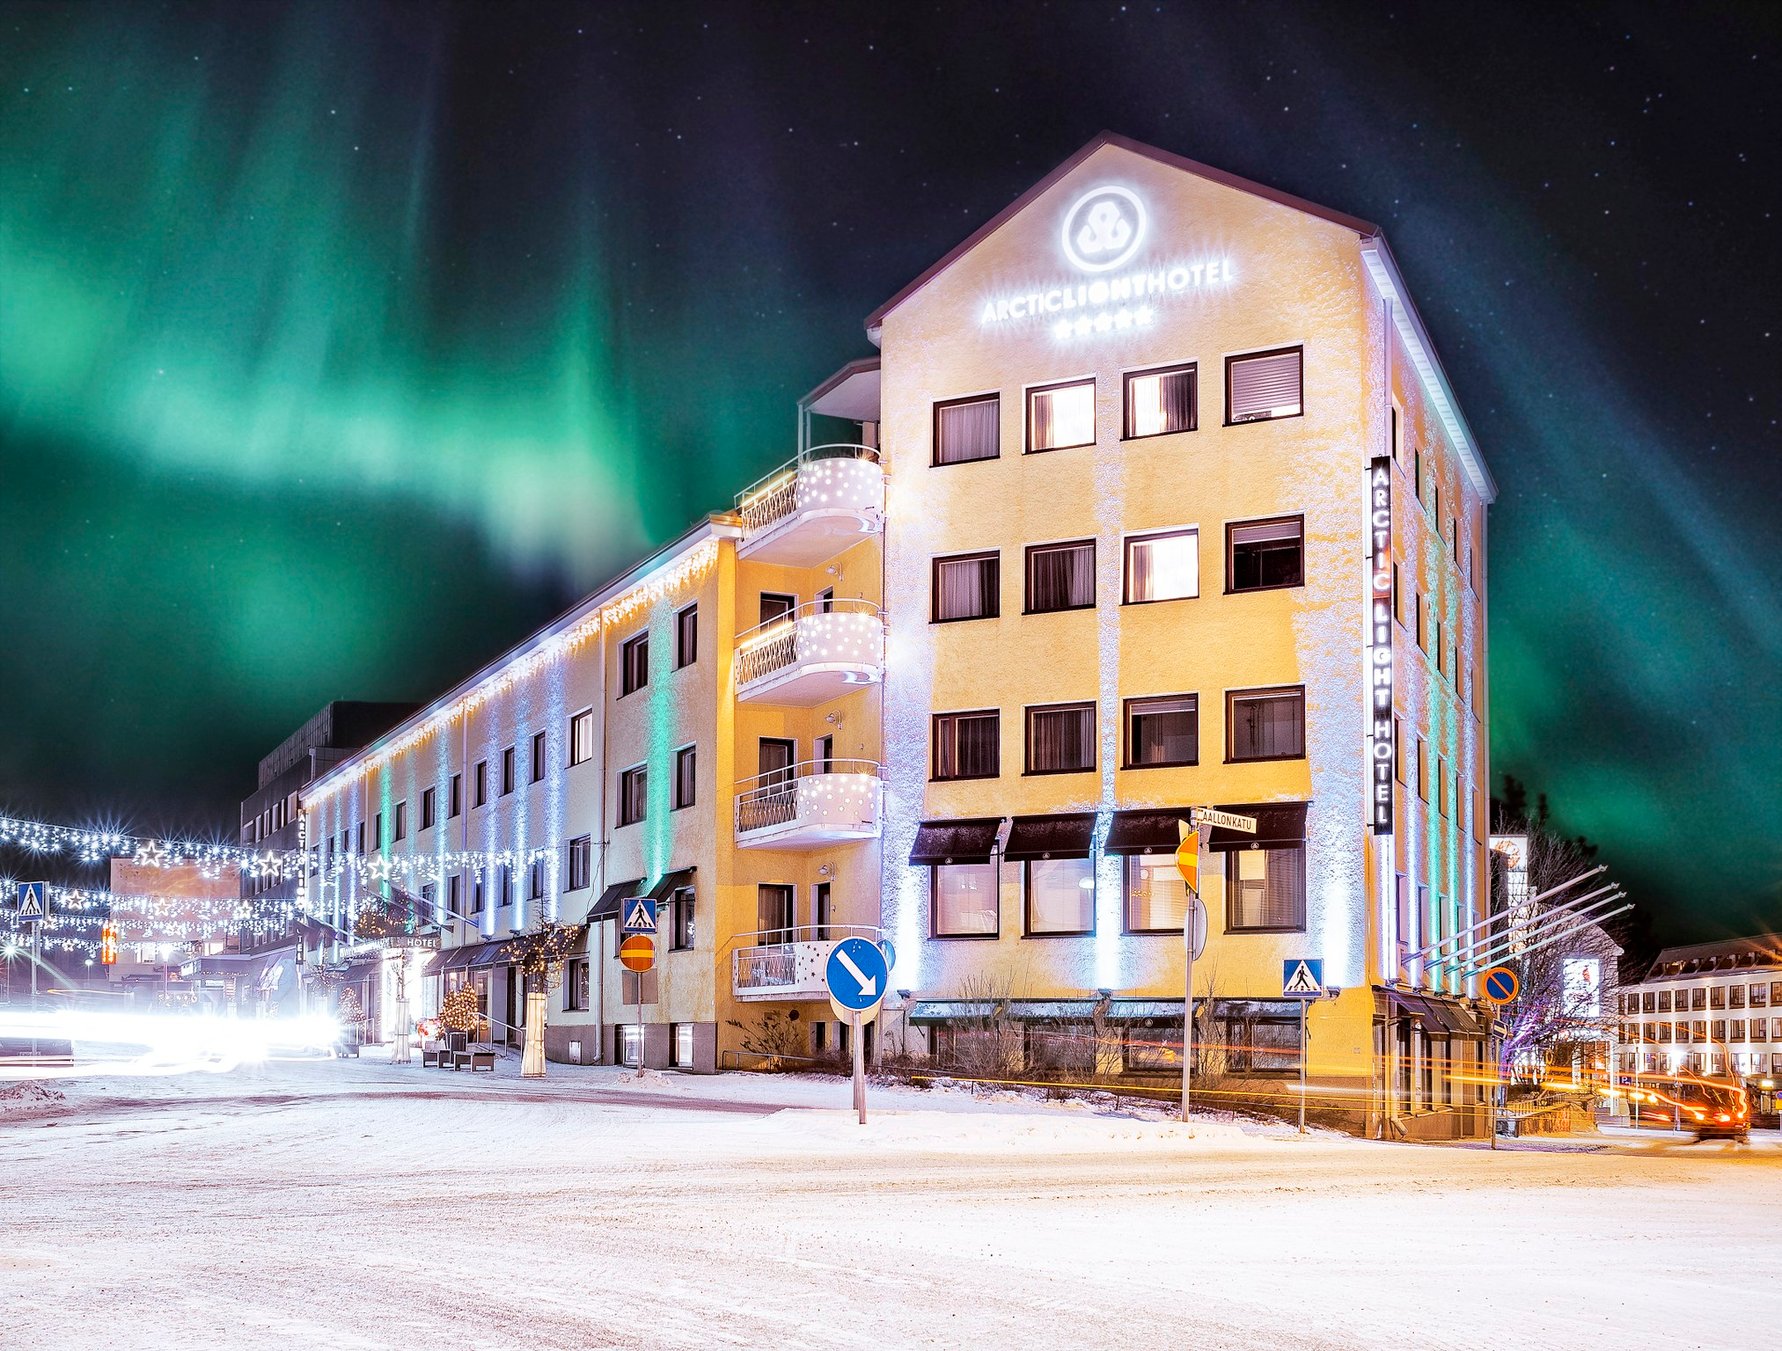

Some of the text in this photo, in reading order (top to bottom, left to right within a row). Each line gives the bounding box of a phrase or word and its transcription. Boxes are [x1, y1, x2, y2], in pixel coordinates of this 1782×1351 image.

[1372, 467, 1390, 590] ARCTIC
[1373, 720, 1391, 823] HOTEL
[1202, 811, 1252, 830] AALLONKATU
[407, 938, 436, 948] HOTEL
